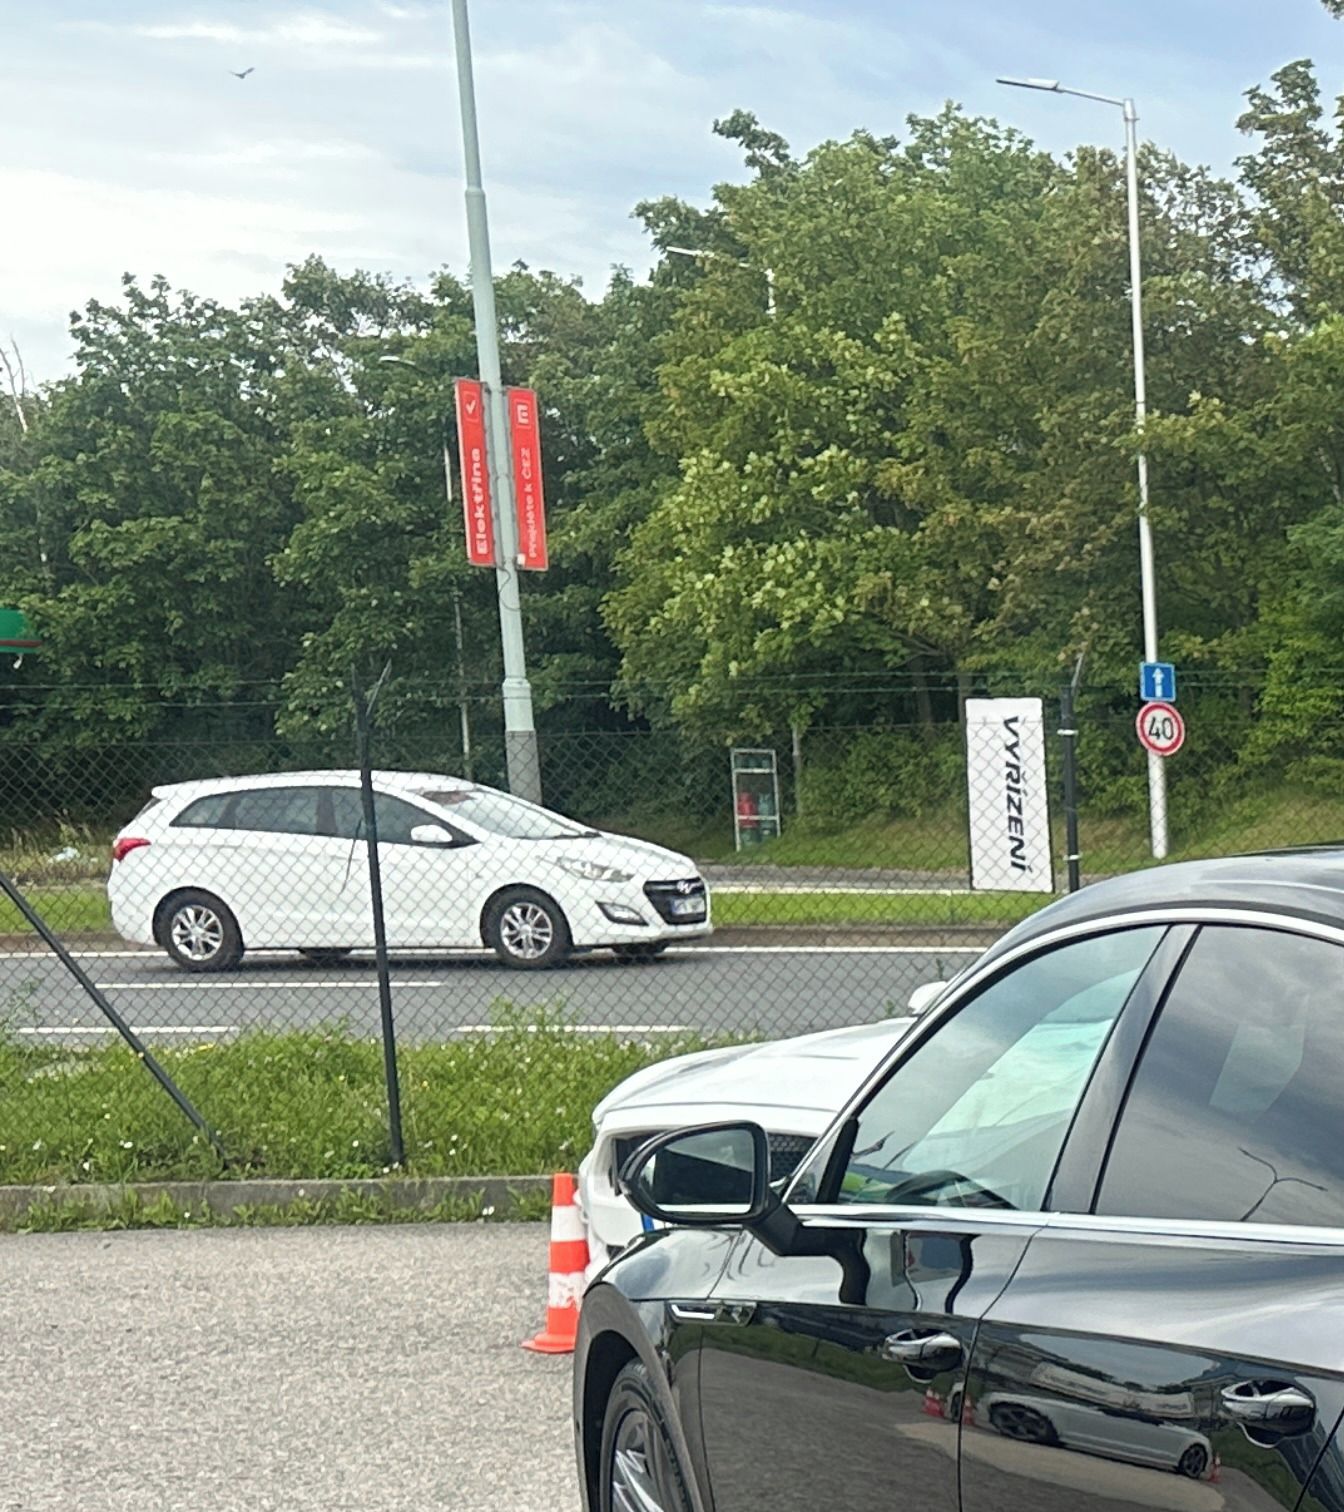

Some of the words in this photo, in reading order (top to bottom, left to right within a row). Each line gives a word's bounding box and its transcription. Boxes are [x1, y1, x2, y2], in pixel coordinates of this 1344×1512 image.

[470, 448, 488, 555] Elektřina
[1149, 716, 1175, 740] 40
[1003, 716, 1033, 873] VYŘÍZENÍ
